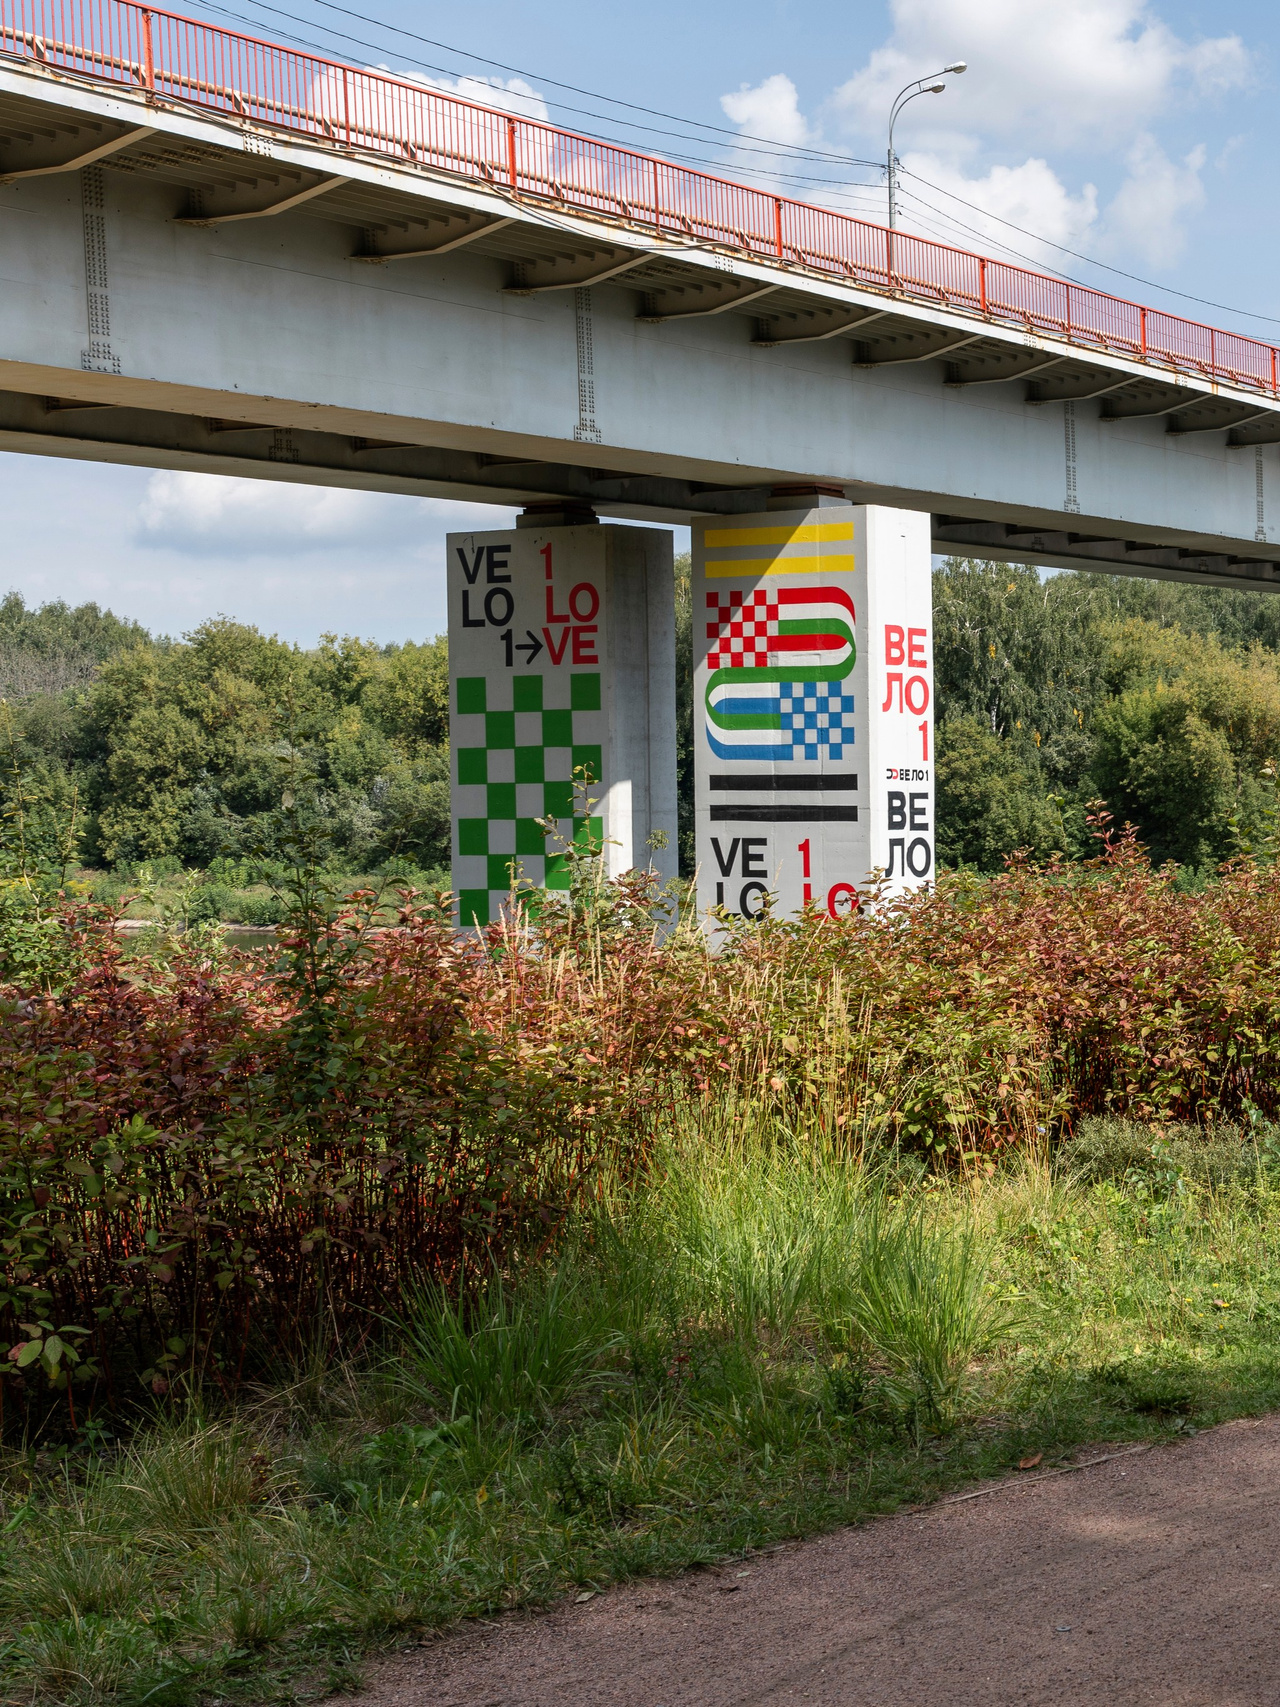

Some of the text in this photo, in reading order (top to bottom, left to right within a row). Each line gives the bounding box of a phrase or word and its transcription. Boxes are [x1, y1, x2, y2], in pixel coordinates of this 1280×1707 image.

[456, 542, 553, 584] VE 1
[462, 582, 600, 628] LO LO
[500, 624, 599, 667] 1 VE
[884, 624, 928, 669] ВЕ
[882, 672, 930, 716] ЛО
[918, 720, 929, 761] 1
[887, 791, 929, 831] ВЕ
[710, 837, 811, 878] VE 1
[885, 837, 931, 878] ЛО
[716, 881, 770, 922] LO
